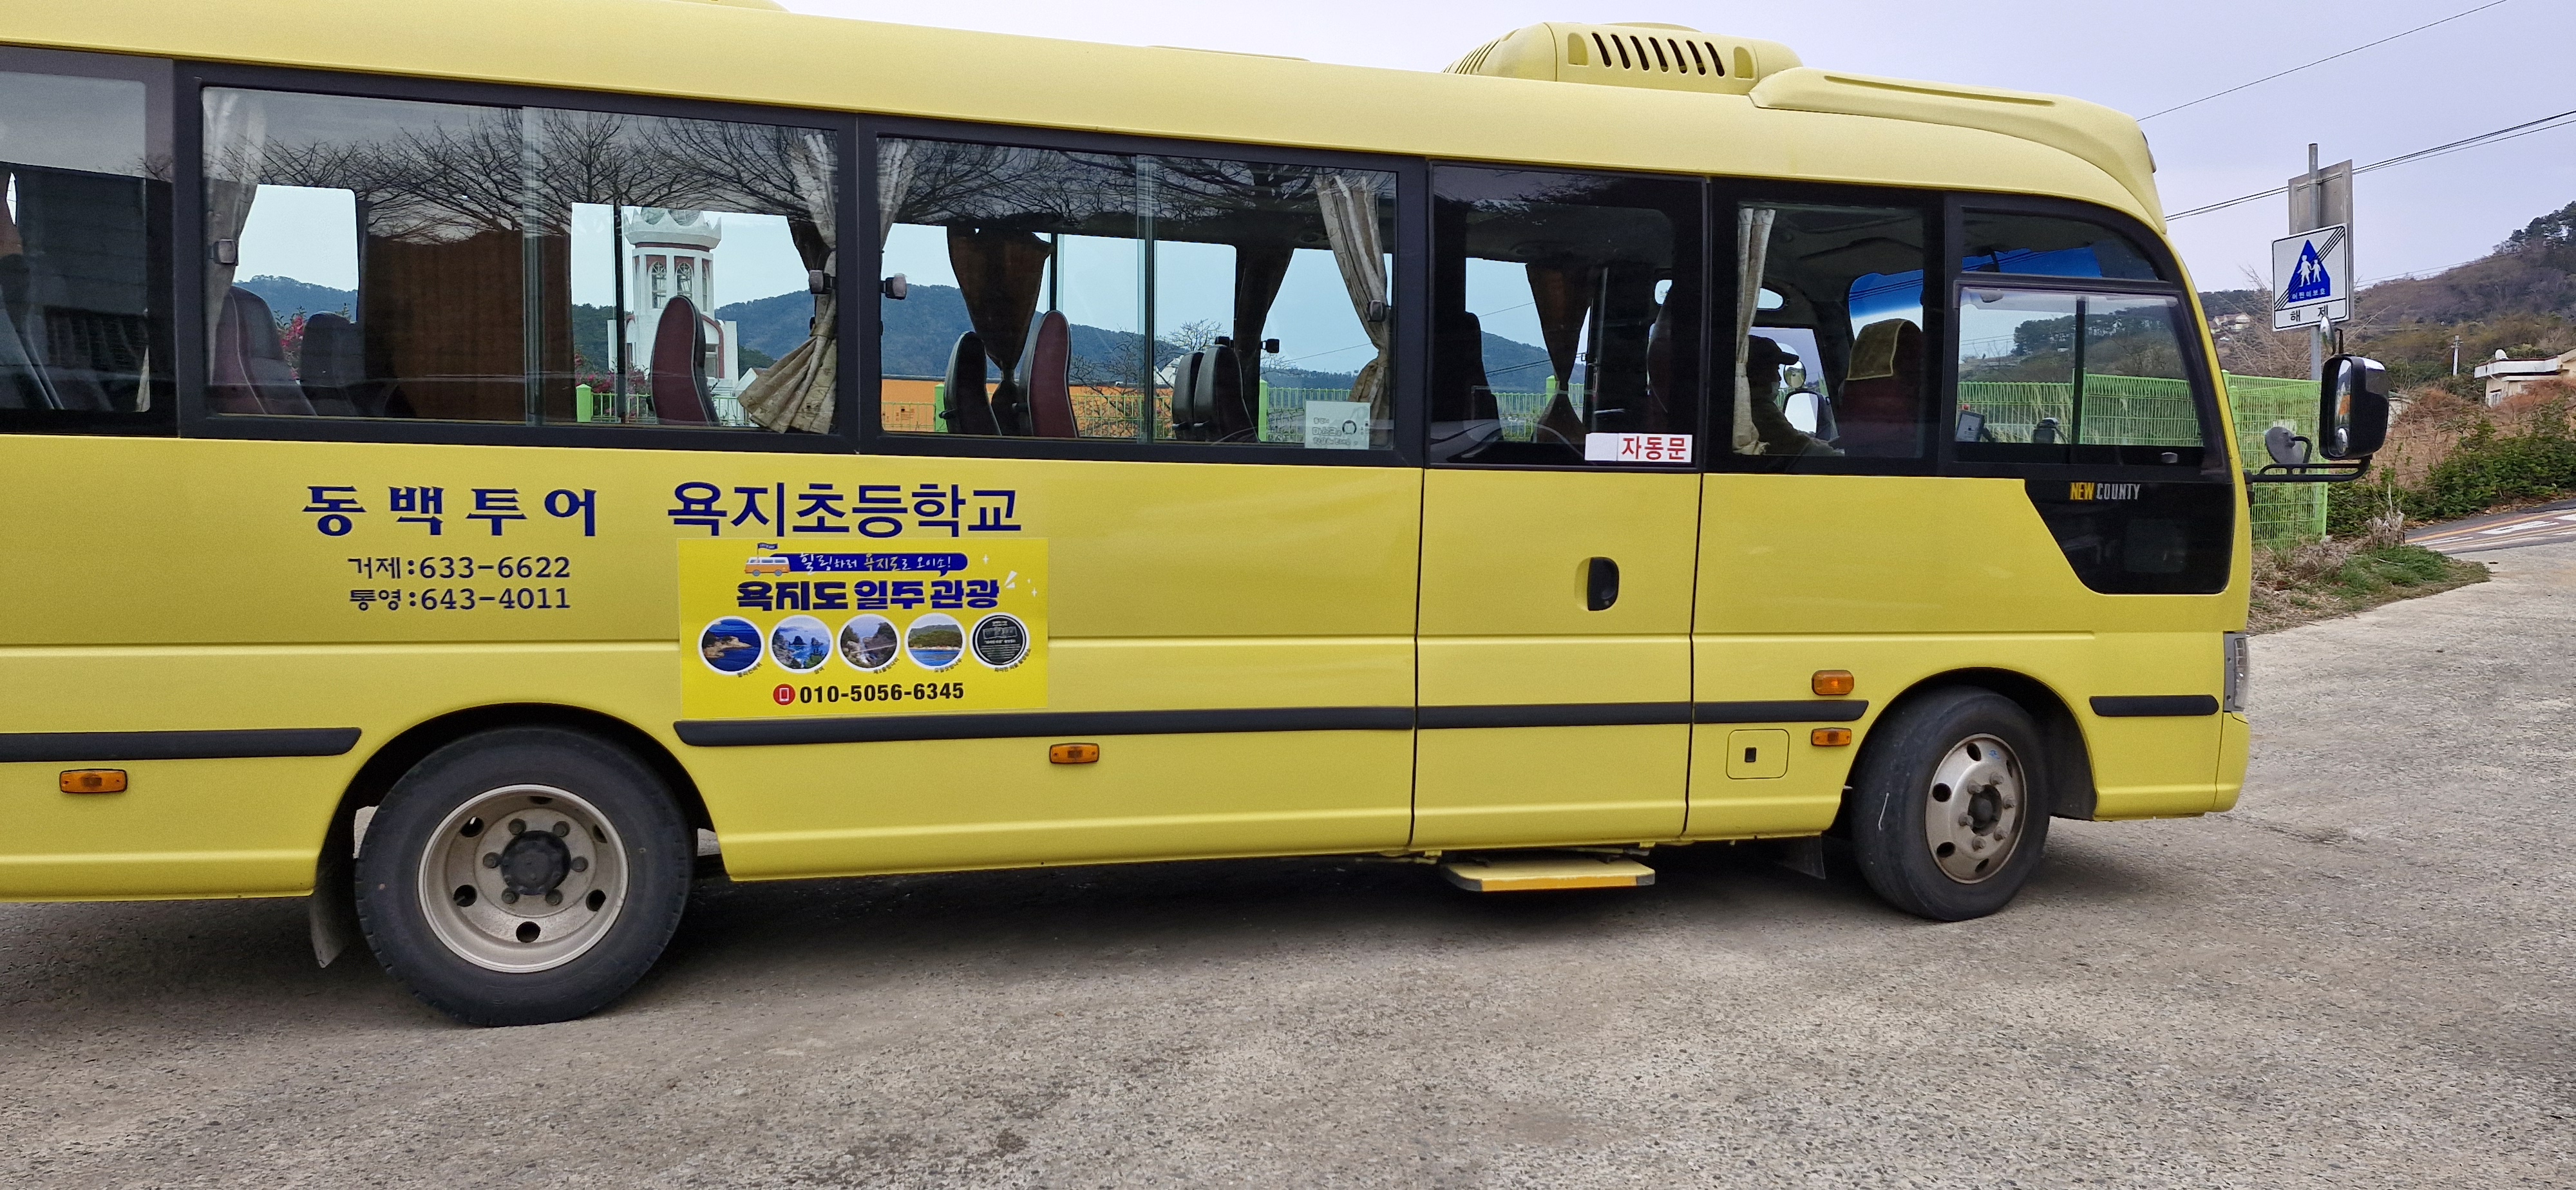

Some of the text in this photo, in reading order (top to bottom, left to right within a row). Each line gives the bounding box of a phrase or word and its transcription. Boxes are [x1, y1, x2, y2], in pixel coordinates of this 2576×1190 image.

[1622, 436, 1686, 460] 자동문
[2069, 482, 2141, 500] NEW COUNTY
[302, 486, 597, 537] 동백투어
[667, 481, 1022, 538] 욕지초등학교
[348, 556, 571, 579] 거제:633-6622
[800, 552, 951, 575] 힐링하러 욕지도로 오이소!
[737, 579, 1000, 611] 욕지도 일주 관광
[800, 682, 964, 703] 010-5056-6345
